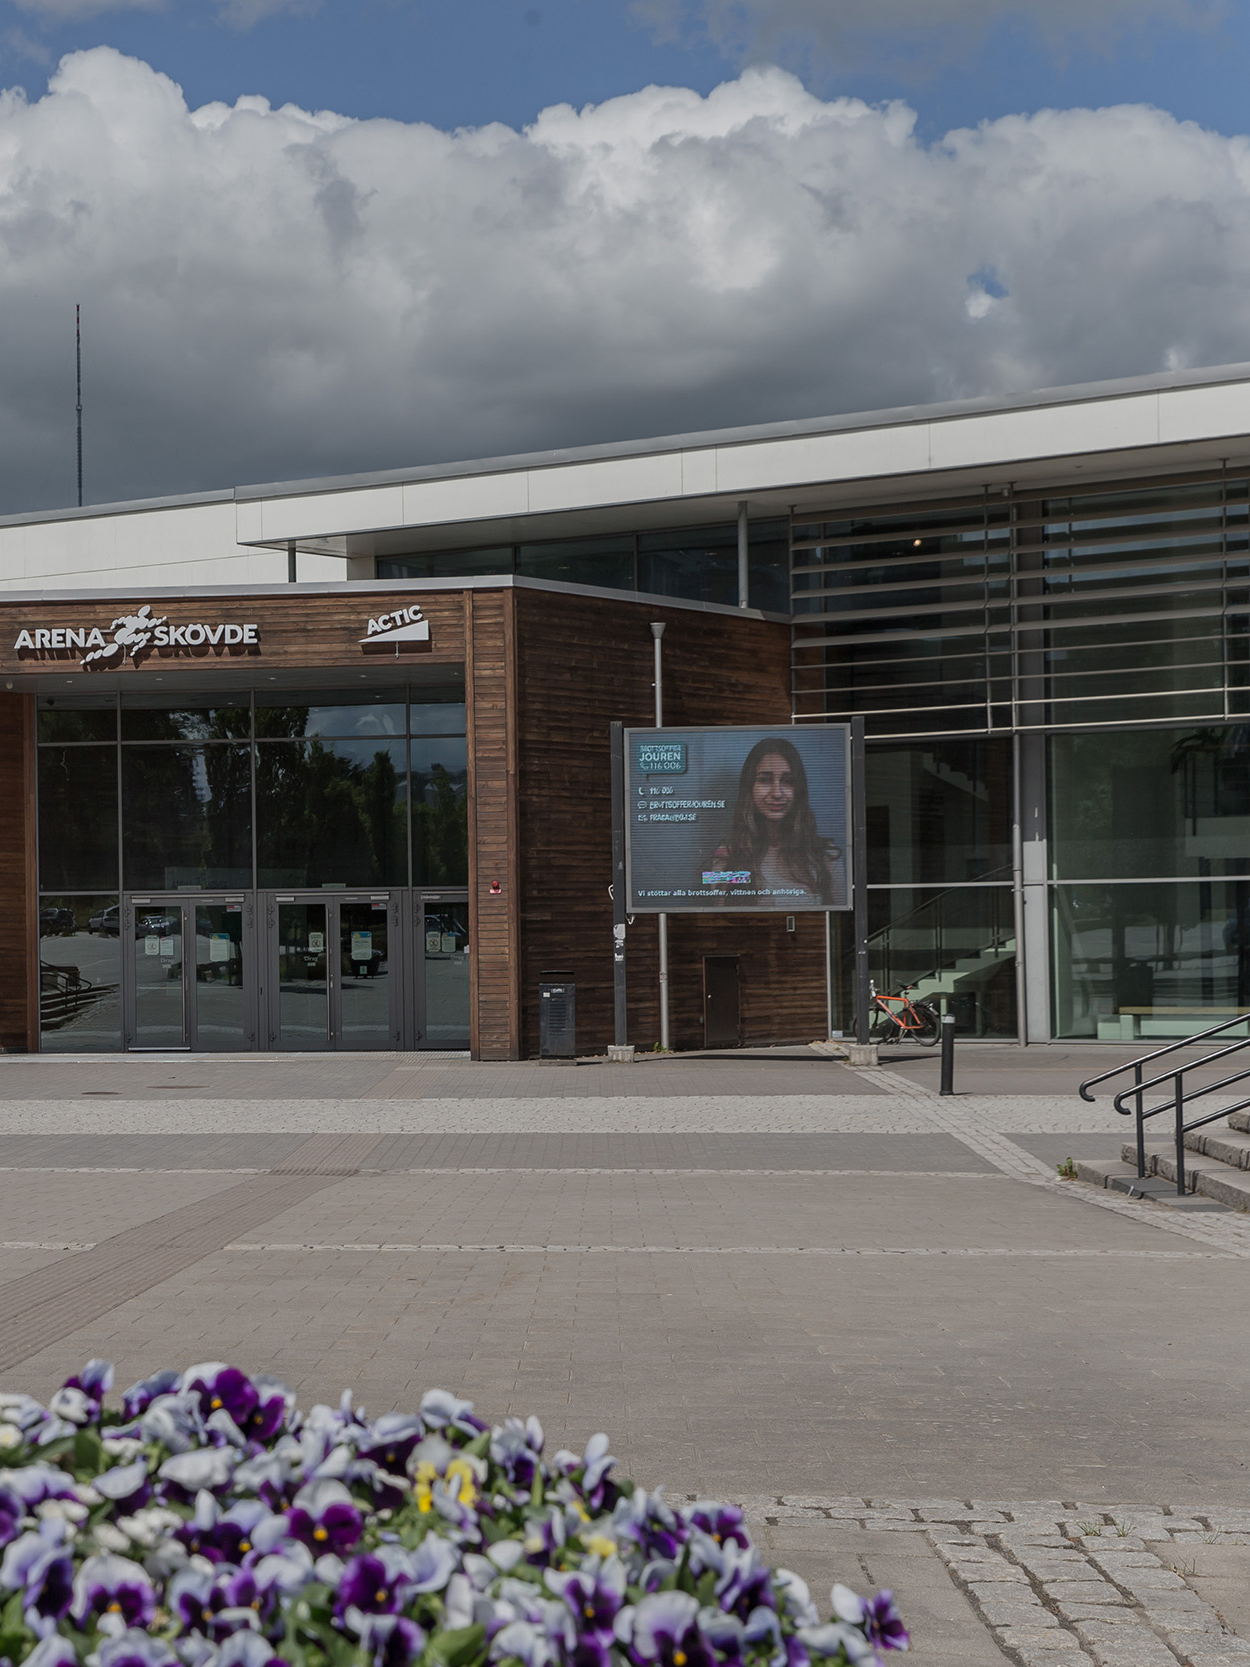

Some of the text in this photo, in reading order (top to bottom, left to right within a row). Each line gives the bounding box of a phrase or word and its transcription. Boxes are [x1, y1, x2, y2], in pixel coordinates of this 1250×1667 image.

[366, 604, 424, 636] ACTIC
[14, 623, 258, 650] ARENA SKÖVDE
[639, 752, 681, 761] JOUREN
[647, 889, 672, 897] stöttar
[688, 889, 728, 897] brottsoffer,
[730, 888, 756, 896] vittnen
[757, 888, 771, 896] och
